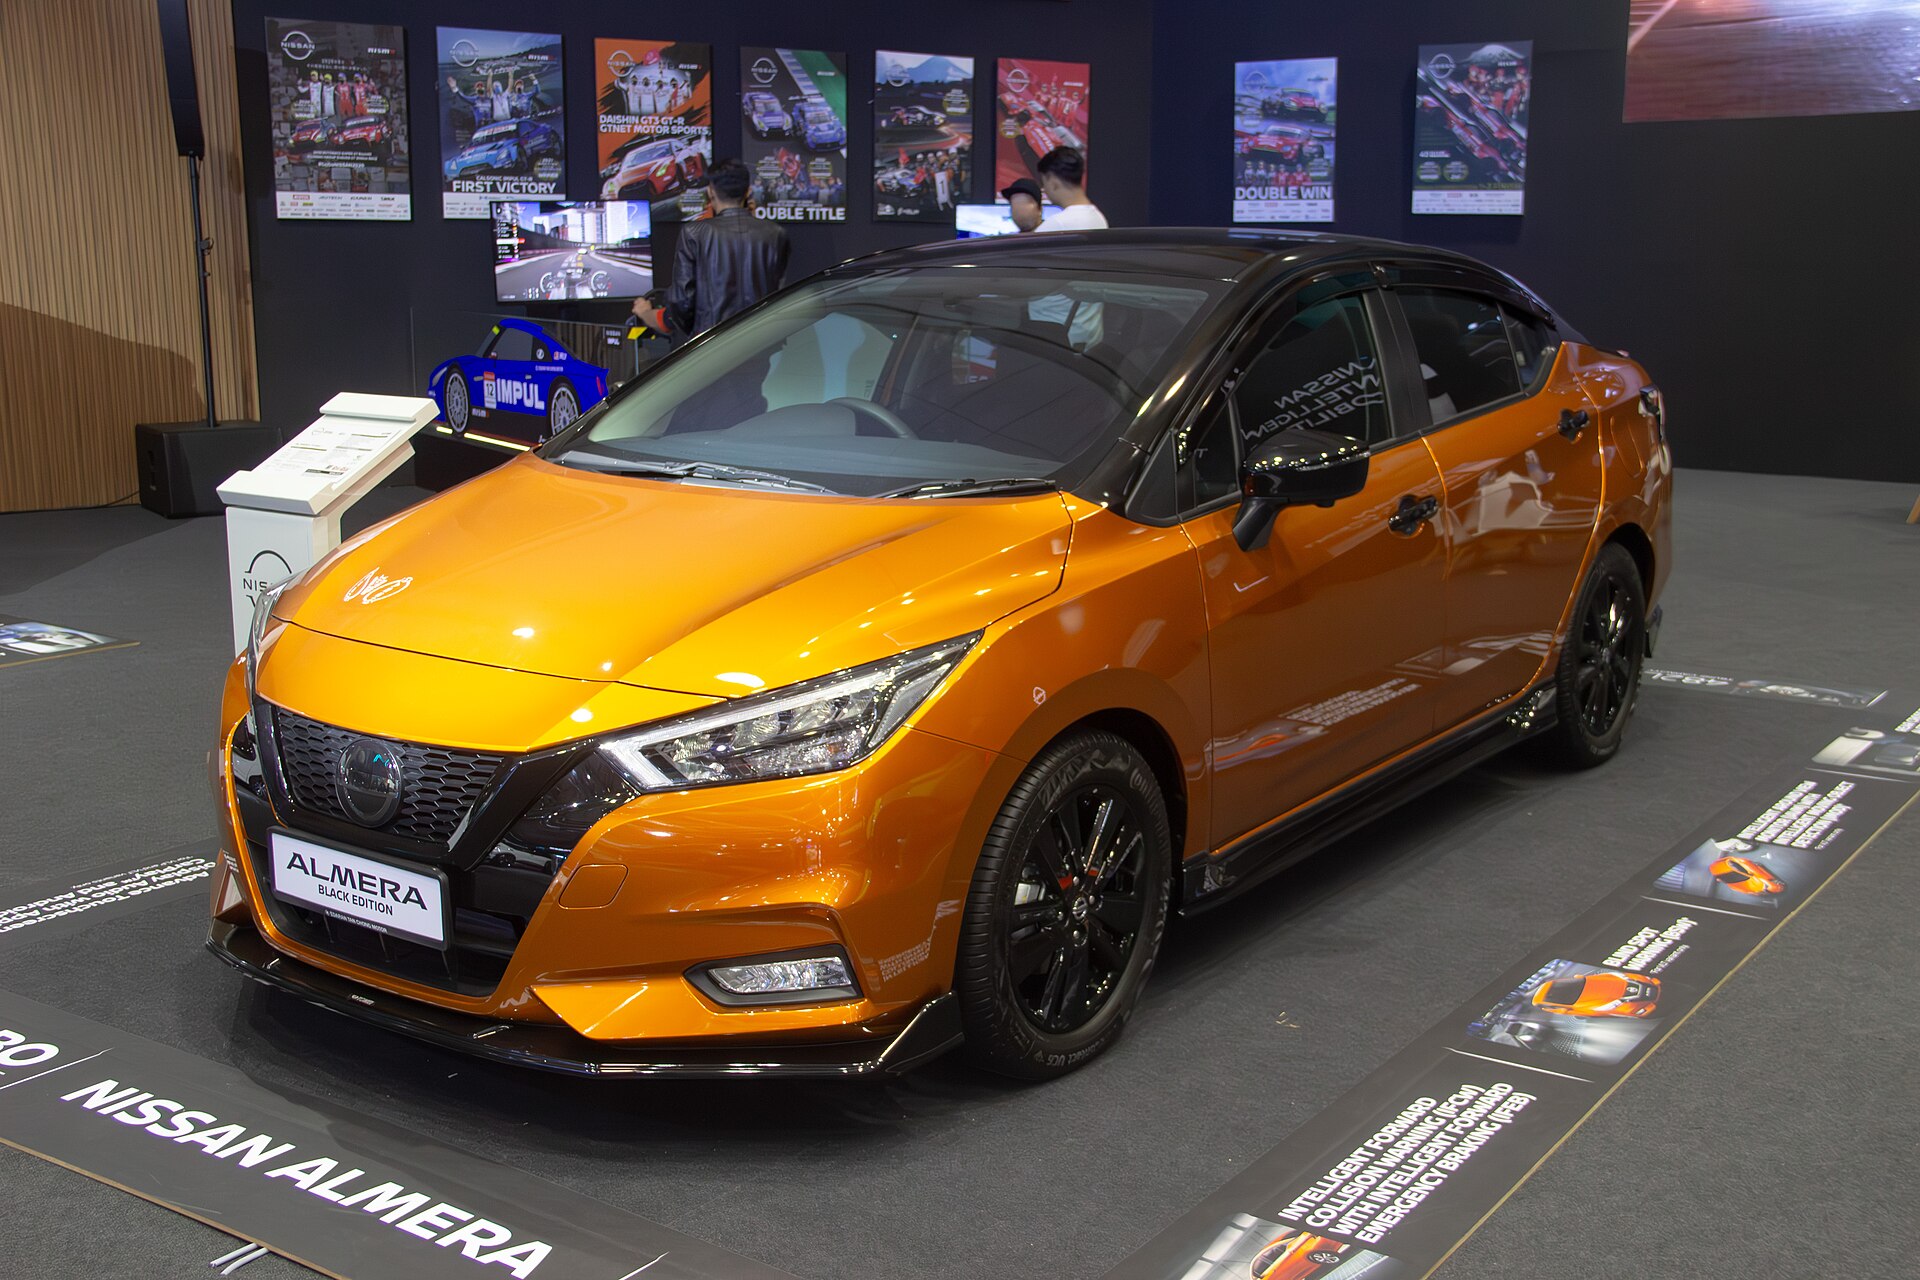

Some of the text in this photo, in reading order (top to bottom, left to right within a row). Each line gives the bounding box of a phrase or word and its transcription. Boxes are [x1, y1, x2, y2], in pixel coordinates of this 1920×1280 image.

[281, 41, 315, 50] NISSAN
[599, 114, 685, 126] DAISHIN GT3 GT-R
[599, 125, 633, 133] GTNET
[633, 125, 670, 135] MOTOR
[452, 181, 557, 194] FIRST VICTORY
[1235, 186, 1331, 200] DOUBLE WIN
[755, 206, 846, 221] OUBLE TITLE
[486, 383, 494, 397] 12
[496, 378, 545, 411] IMPUL
[151, 861, 216, 883] Display
[287, 852, 428, 911] ALMERA
[77, 880, 119, 895] and
[91, 880, 150, 899] Audio
[318, 884, 393, 916] BLACK EDITION
[0, 871, 210, 933] Advance Touchscreen
[42, 894, 90, 913] with
[1602, 926, 1661, 968] BLIND SPOT
[1623, 938, 1673, 971] WARNING
[1278, 1096, 1438, 1221] INTELLIGENT FORWARD
[1305, 1084, 1487, 1228] COLLISION WARNING (IFCW)
[1328, 1082, 1515, 1236] WITH INTELLIGENT FORWARD
[1354, 1091, 1538, 1245] EMERGENCY BRAKING (IFEB)
[60, 1078, 553, 1280] NISSAN ALMERA
